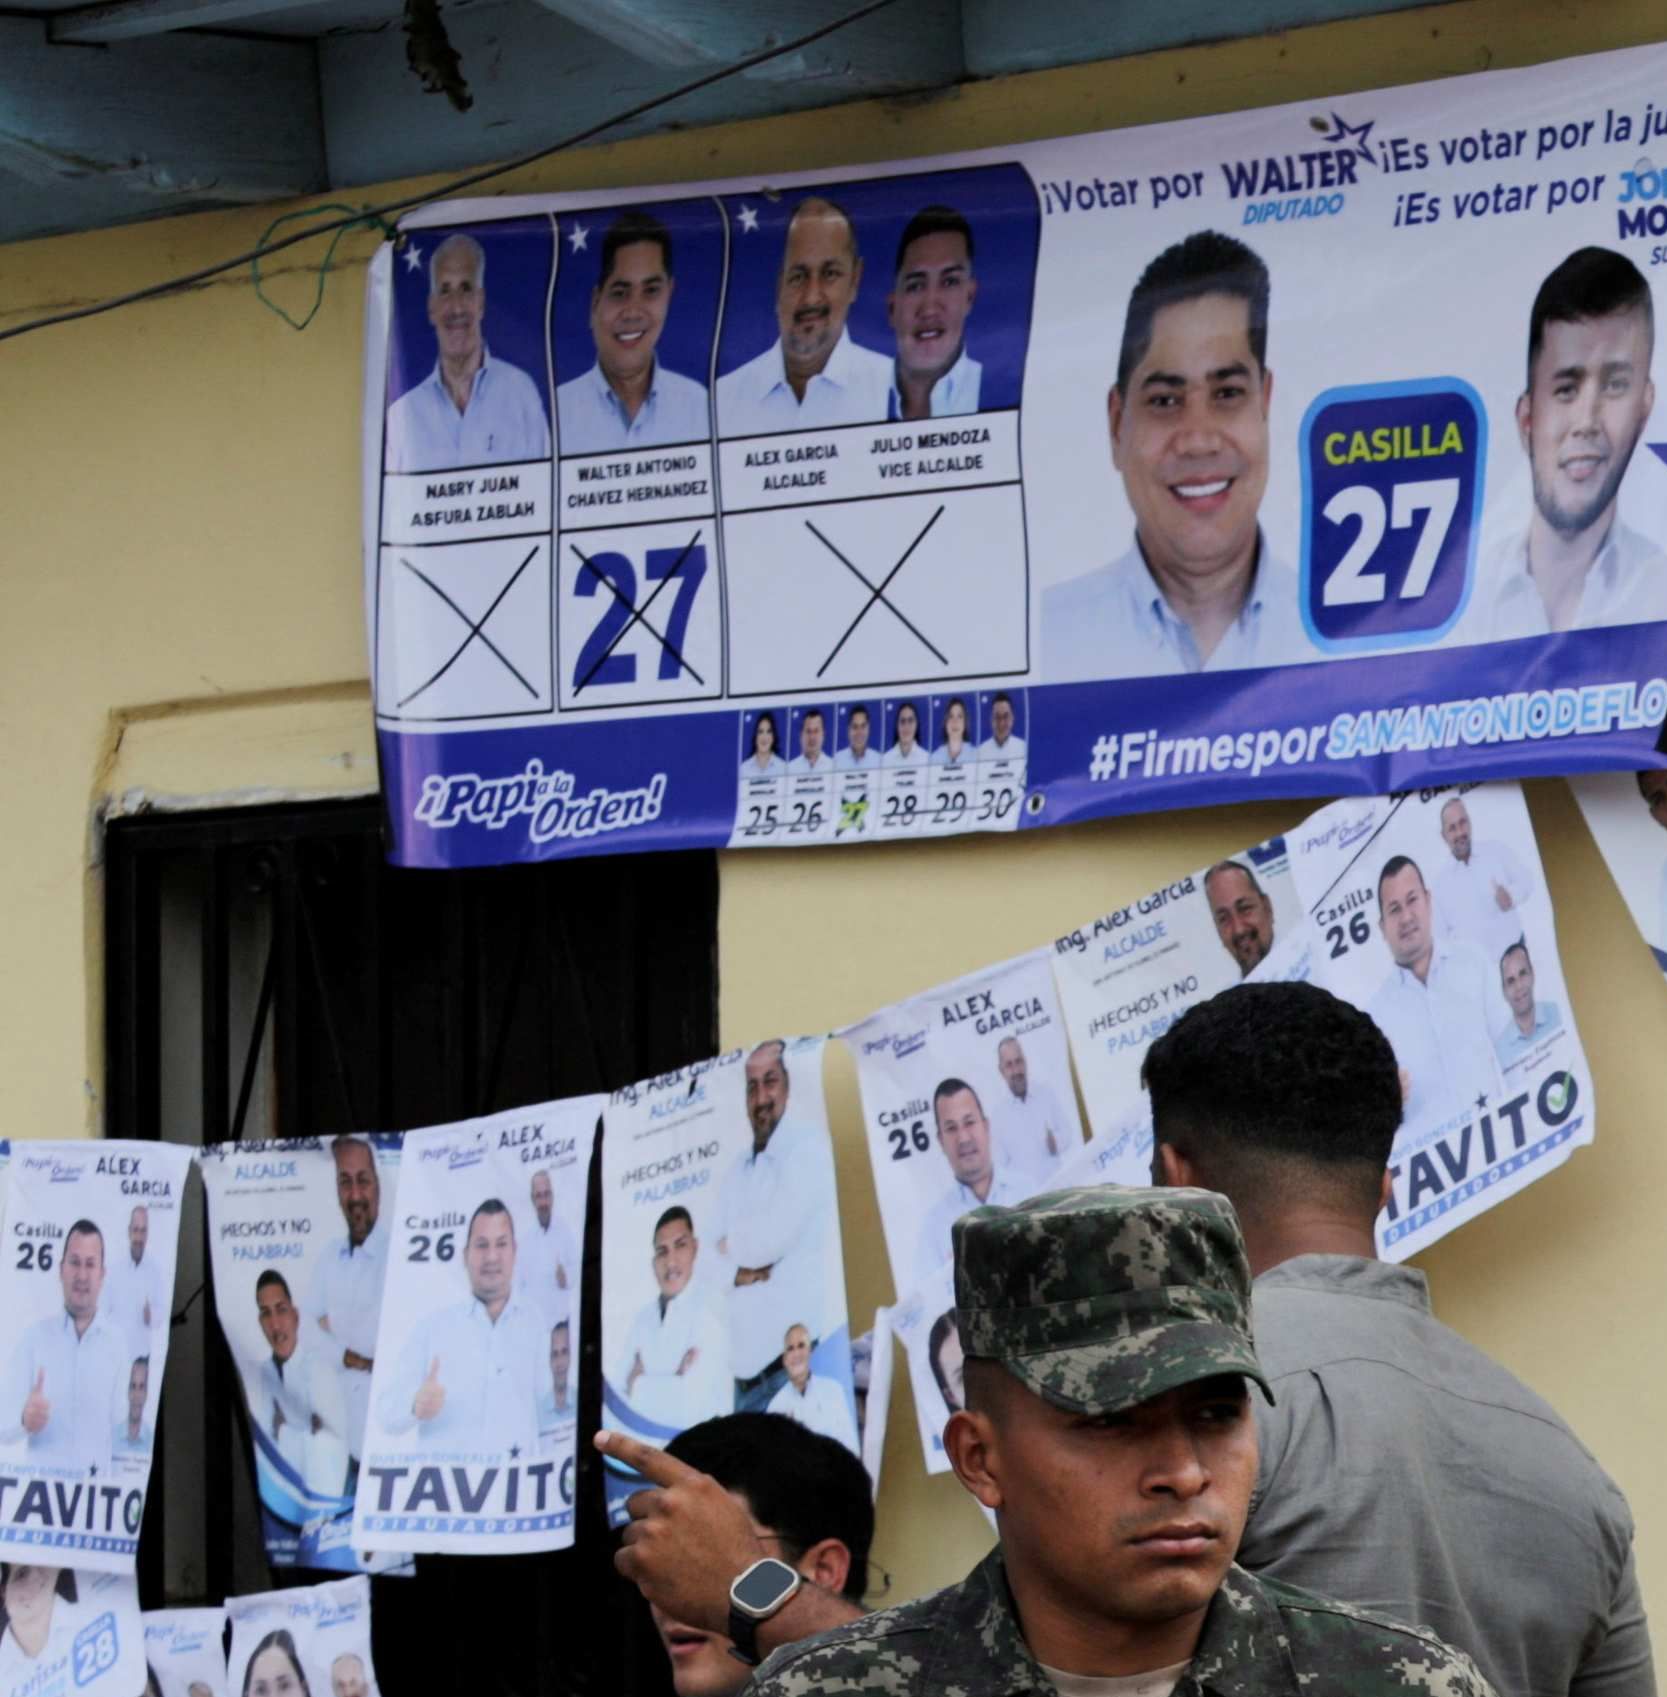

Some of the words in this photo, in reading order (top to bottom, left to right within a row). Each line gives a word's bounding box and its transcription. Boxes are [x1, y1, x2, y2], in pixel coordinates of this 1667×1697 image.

[1040, 178, 1140, 216] ¡Votar
[1151, 169, 1204, 212] por
[1220, 147, 1358, 200] WALTER
[1379, 136, 1431, 174] ¡Es
[1440, 124, 1528, 167] votar
[1537, 116, 1594, 162] por
[1604, 106, 1633, 145] la
[1242, 193, 1345, 226] DIPUTADO
[1394, 188, 1442, 228] ¡Es
[1453, 179, 1539, 219] votar
[1547, 171, 1606, 217] por
[745, 447, 782, 468] ALEX
[785, 442, 839, 464] GARCIA
[869, 433, 913, 455] JULIO
[917, 427, 991, 450] MENDOZA
[1324, 421, 1463, 467] CASILLA
[577, 461, 630, 483] WALTER
[634, 455, 697, 477] ANTONIO
[762, 470, 827, 491] ALCALDE
[878, 459, 913, 479] VICE
[917, 453, 984, 476] ALCALDE
[425, 479, 476, 499] NASRY
[479, 474, 519, 494] JUAN
[567, 487, 623, 510] CHAVEZ
[626, 478, 708, 504] HERNANDEZ
[410, 505, 473, 528] ASFURA
[476, 500, 535, 523] ZABLAH
[1322, 477, 1460, 606] 27
[572, 545, 708, 687] 27
[529, 773, 667, 843] Orden!
[744, 804, 779, 836] 25
[788, 800, 823, 833] 26
[883, 794, 918, 827] 28
[932, 790, 967, 823] 29
[976, 787, 1014, 821] 30
[1316, 887, 1374, 927] Casilla
[1103, 920, 1167, 963] ALCALDE
[1326, 911, 1371, 959] 26
[1161, 988, 1174, 1007] Y
[1173, 974, 1199, 997] NO
[941, 989, 996, 1027] ALEX
[975, 997, 1044, 1036] GARCIA
[1107, 1005, 1186, 1055] PALABRA
[878, 1097, 931, 1127] Casilla
[498, 1123, 545, 1149] ALEX
[520, 1137, 576, 1163] GARCIA
[697, 1140, 720, 1159] NO
[888, 1120, 930, 1161] 26
[95, 1155, 143, 1177] ALEX
[235, 1160, 298, 1180] ALCALDE
[120, 1179, 172, 1198] GARCIA
[14, 1221, 63, 1239] Casilla
[290, 1218, 312, 1235] NO
[405, 1212, 467, 1230] Casilla
[16, 1241, 53, 1272] 26
[407, 1233, 456, 1262] 26
[78, 1628, 114, 1683] 28
